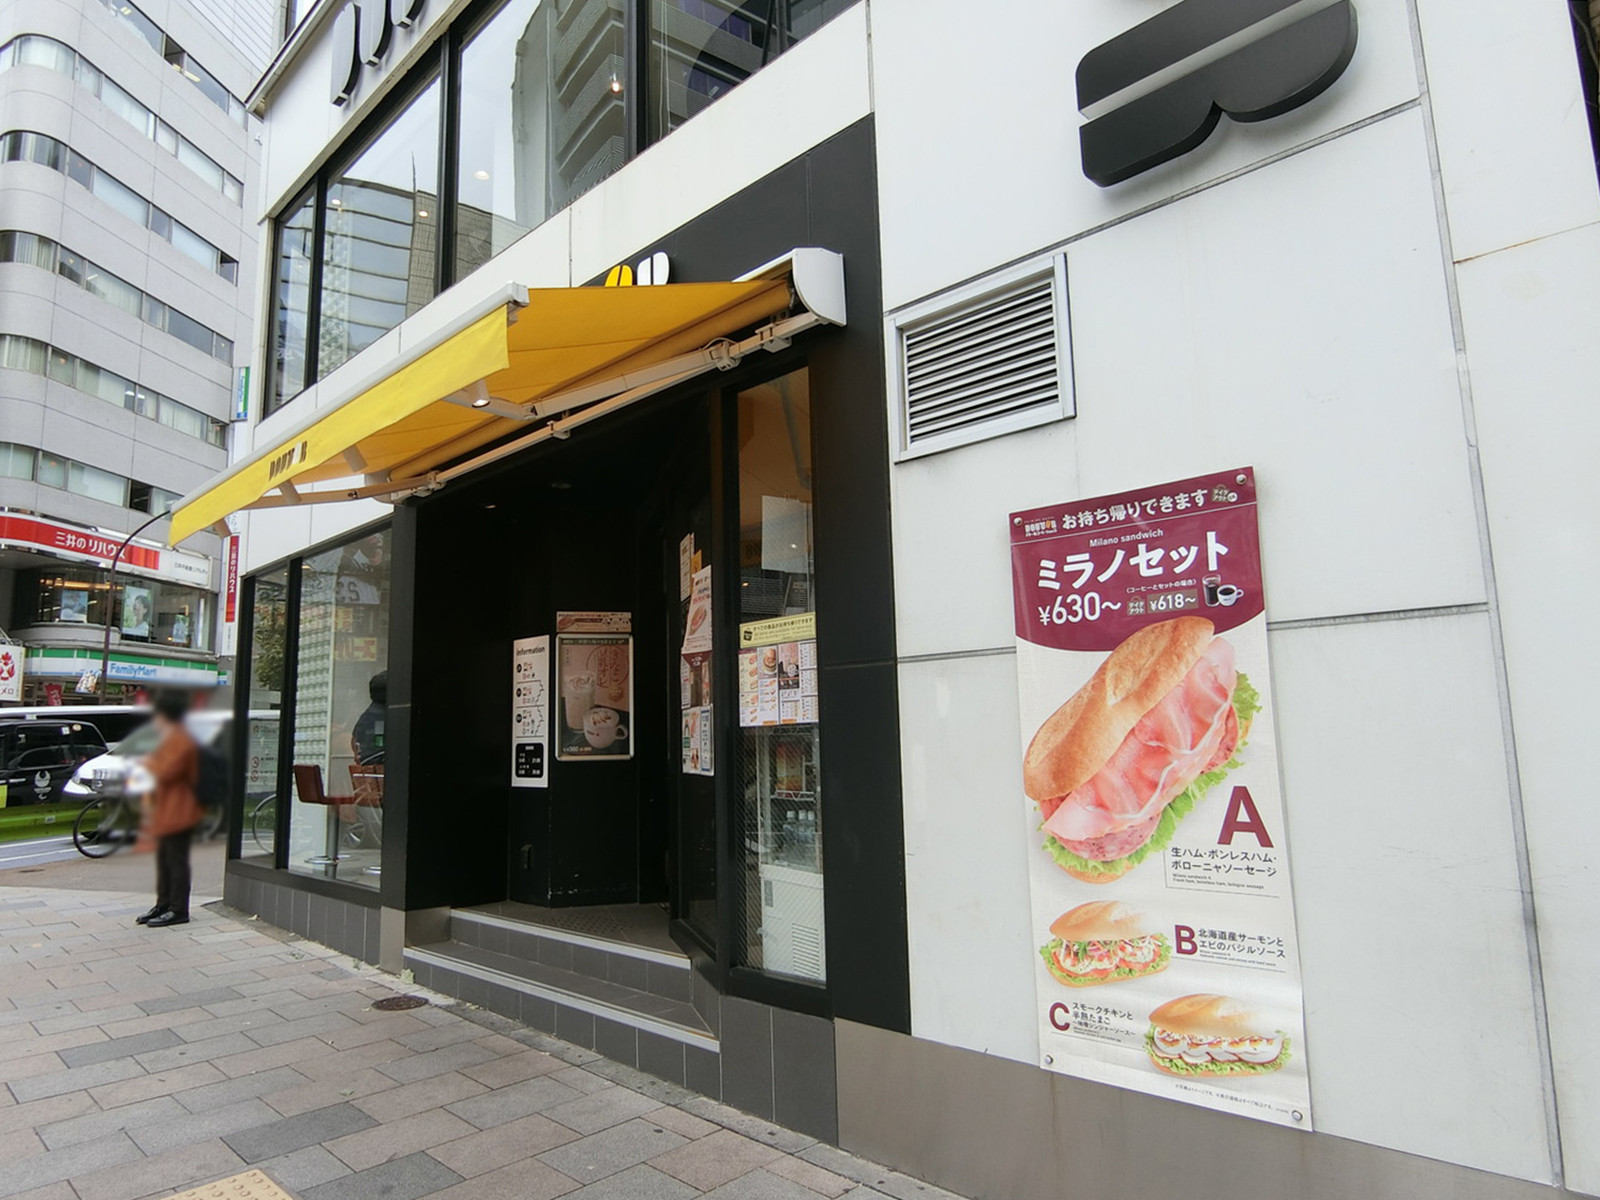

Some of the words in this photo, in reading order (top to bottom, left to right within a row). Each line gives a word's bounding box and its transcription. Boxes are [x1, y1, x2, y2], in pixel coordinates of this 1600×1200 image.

[1062, 489, 1208, 530] お持ち帰りできます
[55, 531, 126, 560] 三井のリハウス
[1089, 536, 1119, 548] Milano
[1121, 529, 1164, 544] sandwich
[1038, 531, 1229, 590] ミラノセット
[109, 662, 157, 677] FamilyMart
[1217, 786, 1274, 848] A
[1175, 924, 1198, 955] B
[1198, 928, 1284, 947] 北海道産サーモンと
[1199, 940, 1286, 959] エビのバジルソース
[1049, 1002, 1070, 1031] C
[1072, 1002, 1133, 1020] スモークチキンと
